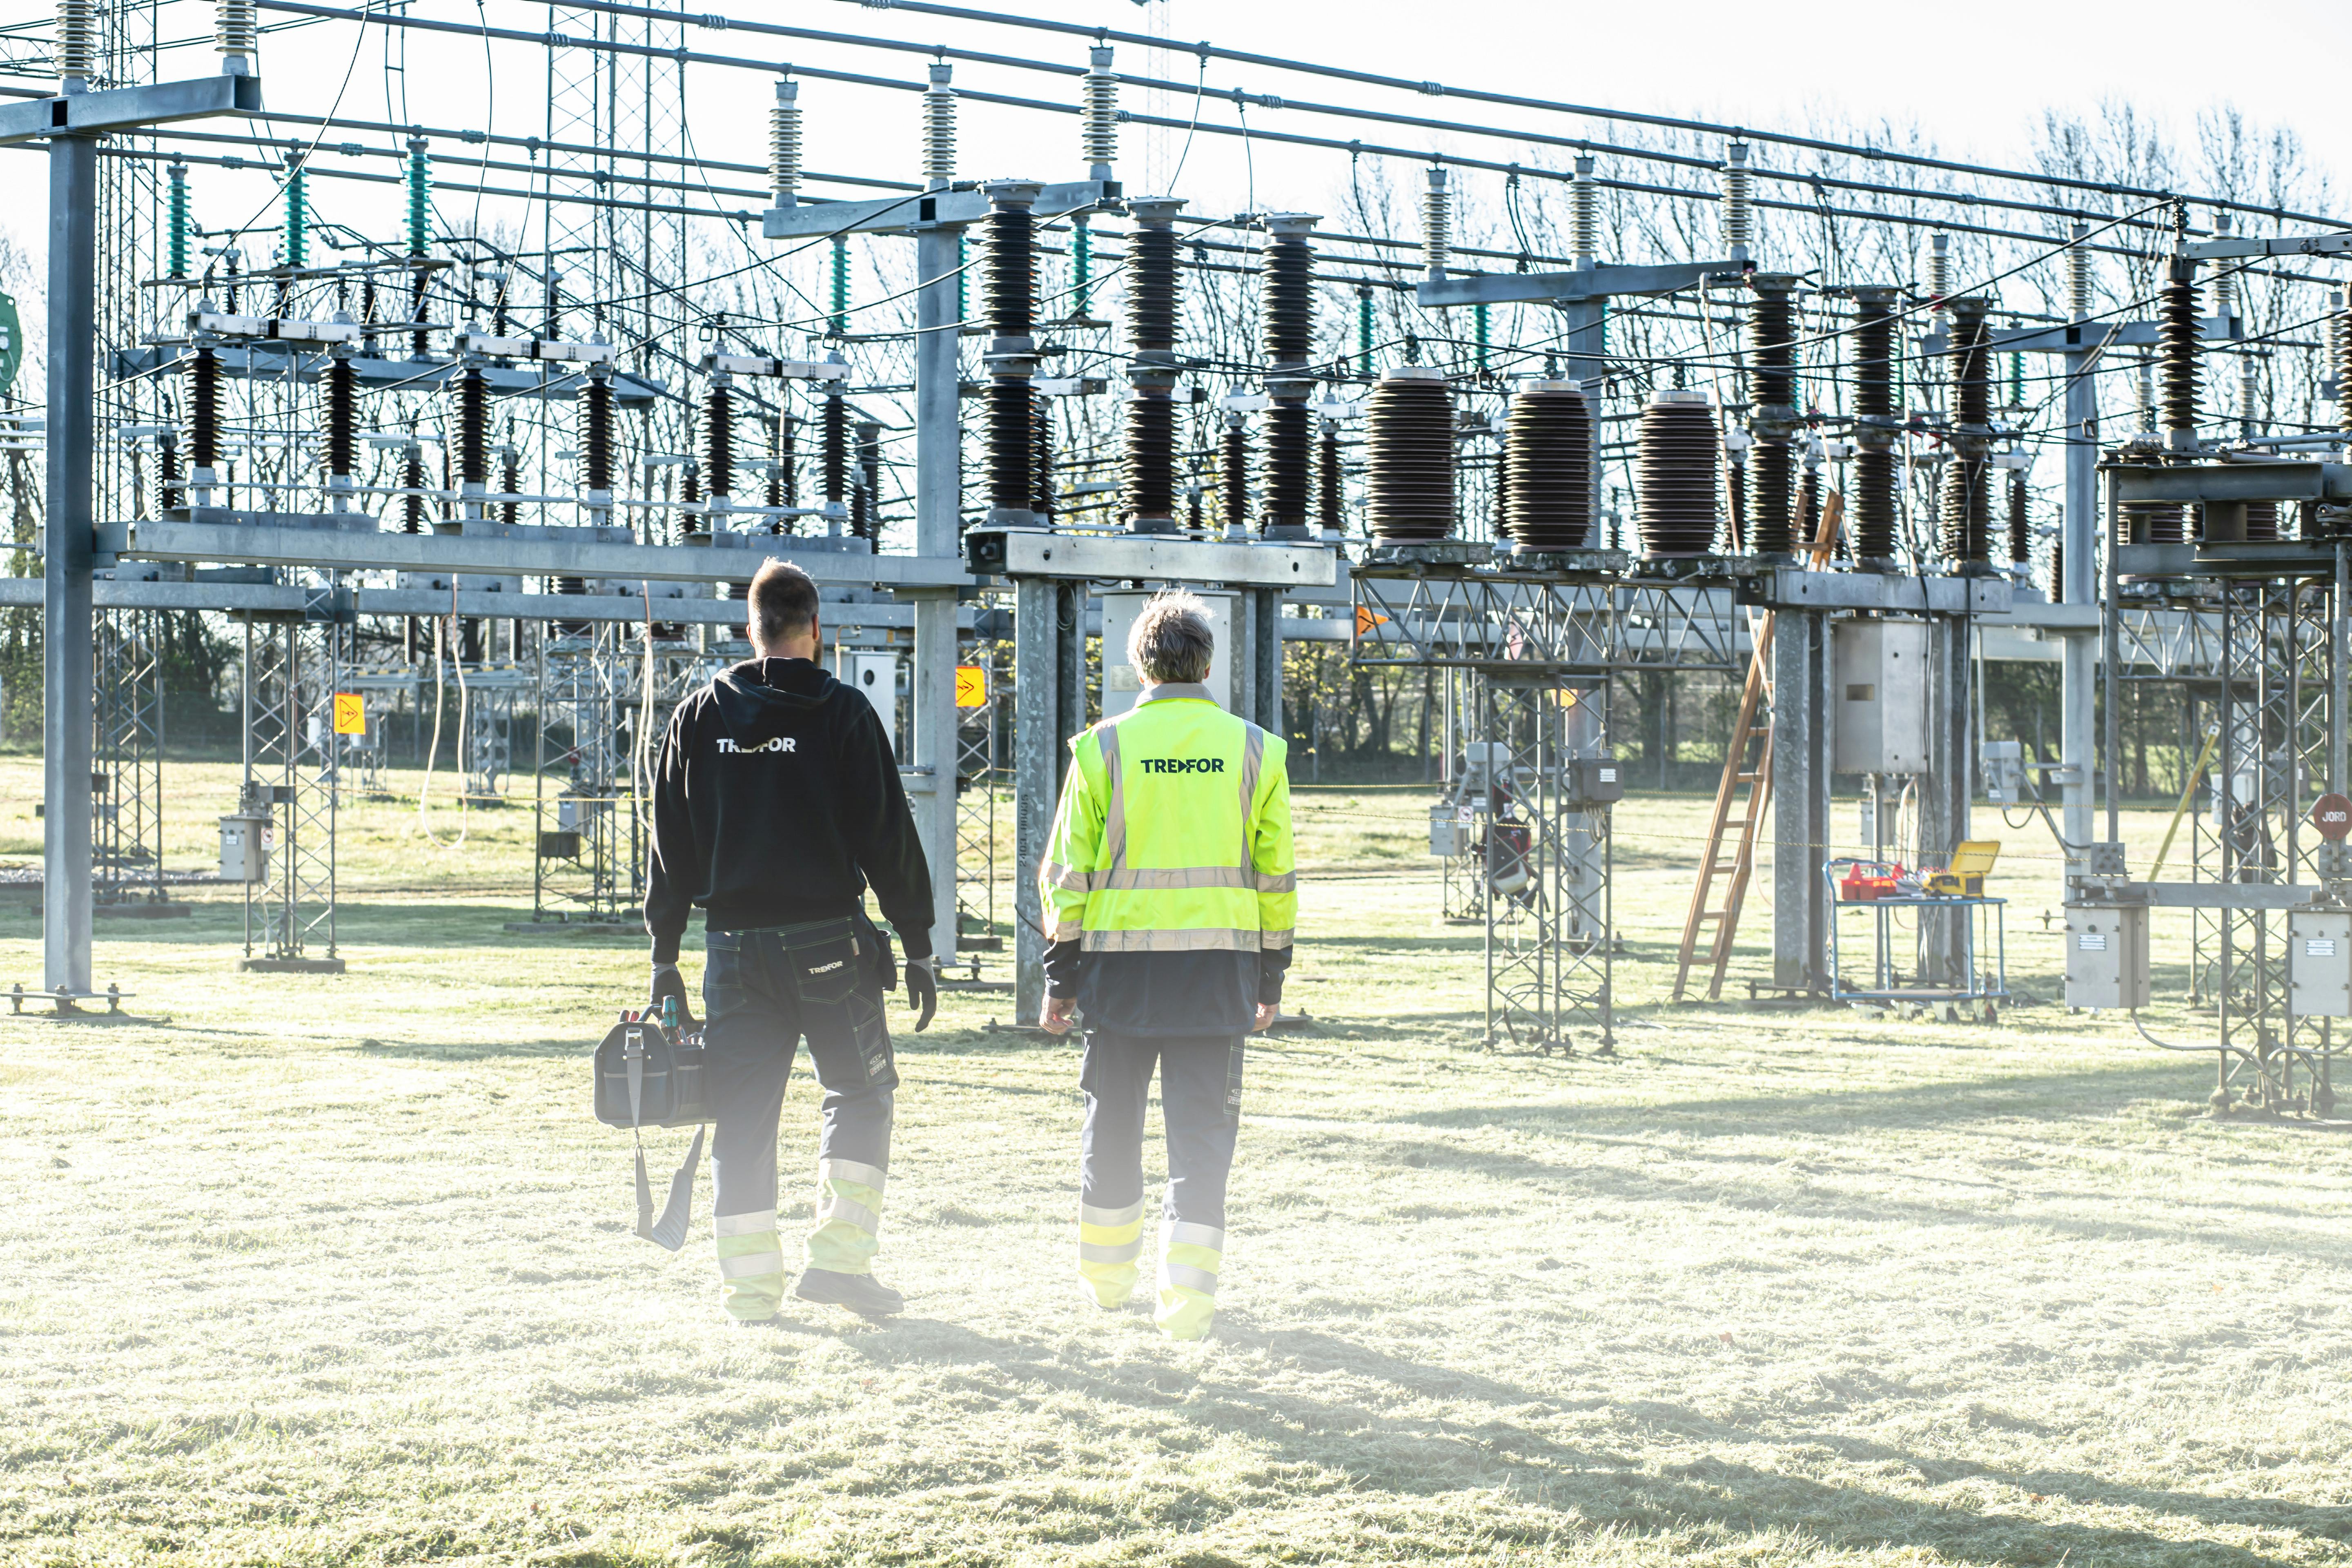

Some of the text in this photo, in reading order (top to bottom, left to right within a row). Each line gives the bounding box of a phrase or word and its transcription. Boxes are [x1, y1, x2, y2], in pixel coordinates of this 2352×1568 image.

[1140, 758, 1225, 773] TREFOR
[2322, 811, 2346, 822] JORD
[808, 961, 843, 974] TREFOR
